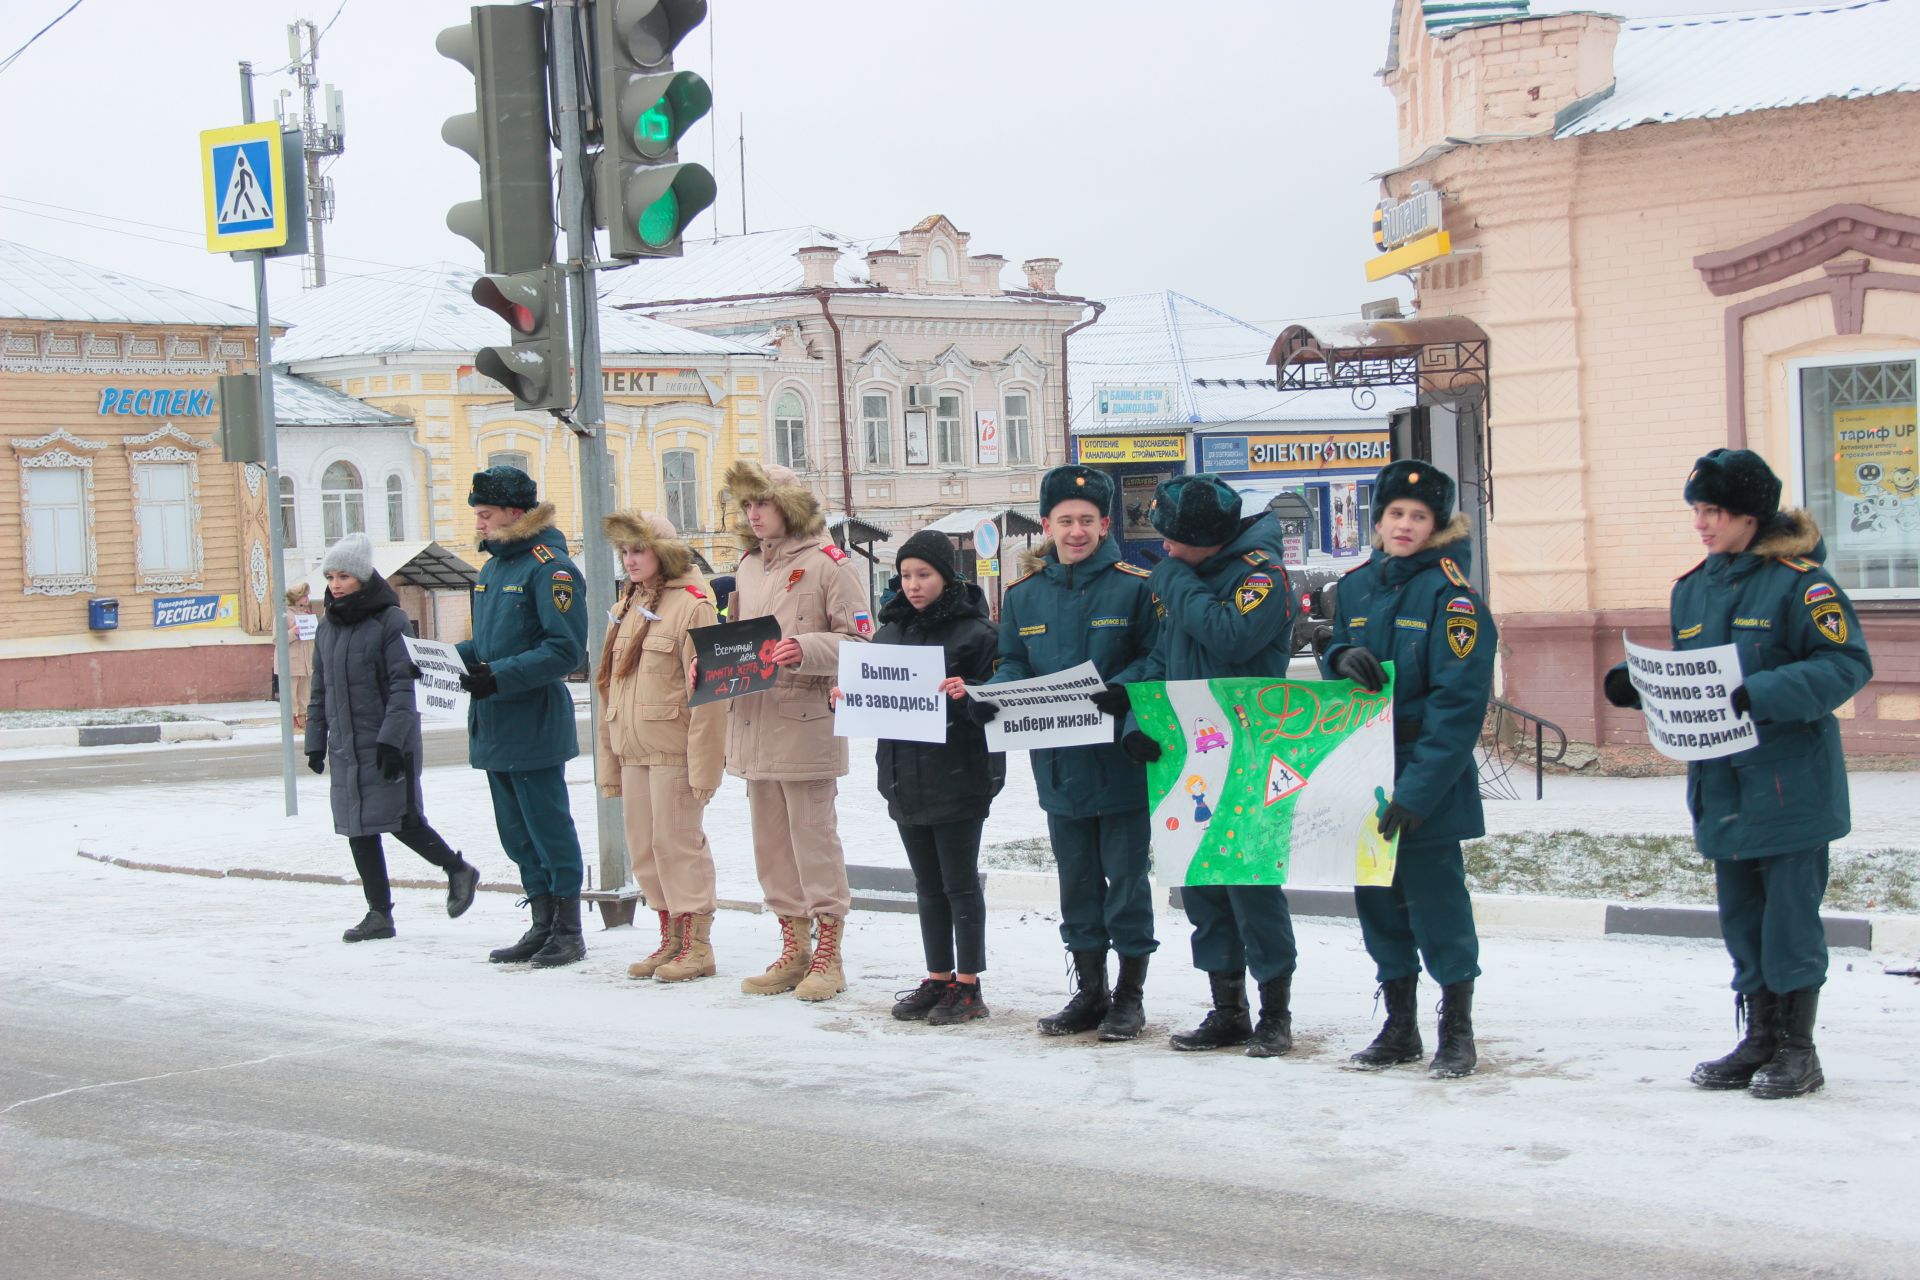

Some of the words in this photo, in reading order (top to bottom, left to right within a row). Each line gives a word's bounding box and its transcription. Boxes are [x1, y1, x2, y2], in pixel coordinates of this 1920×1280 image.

[602, 372, 657, 391] ПЕКТ
[1840, 426, 1890, 443] тариф
[1895, 424, 1916, 438] UP
[1084, 440, 1119, 448] ОТОПЛЕНИЕ
[1133, 440, 1179, 448] ВОДОСНАБЖЕНИЕ
[1253, 442, 1390, 463] ЭЛЕКТРОТОВАР
[1085, 451, 1126, 460] КАНАЛИЗАЦИЯ
[1131, 450, 1179, 459] СТРОЙМАТЕРИАЛЫ
[156, 603, 216, 626] РЕСПЕКТ
[861, 662, 910, 682] Выпил
[1665, 660, 1722, 676] слово,
[433, 677, 467, 693] написа
[714, 676, 751, 695] ДТП
[1706, 684, 1727, 699] за
[426, 695, 456, 711] кровью!
[846, 693, 863, 708] не
[866, 694, 939, 713] заводись!
[1003, 716, 1055, 734] выбери
[1669, 708, 1727, 724] может
